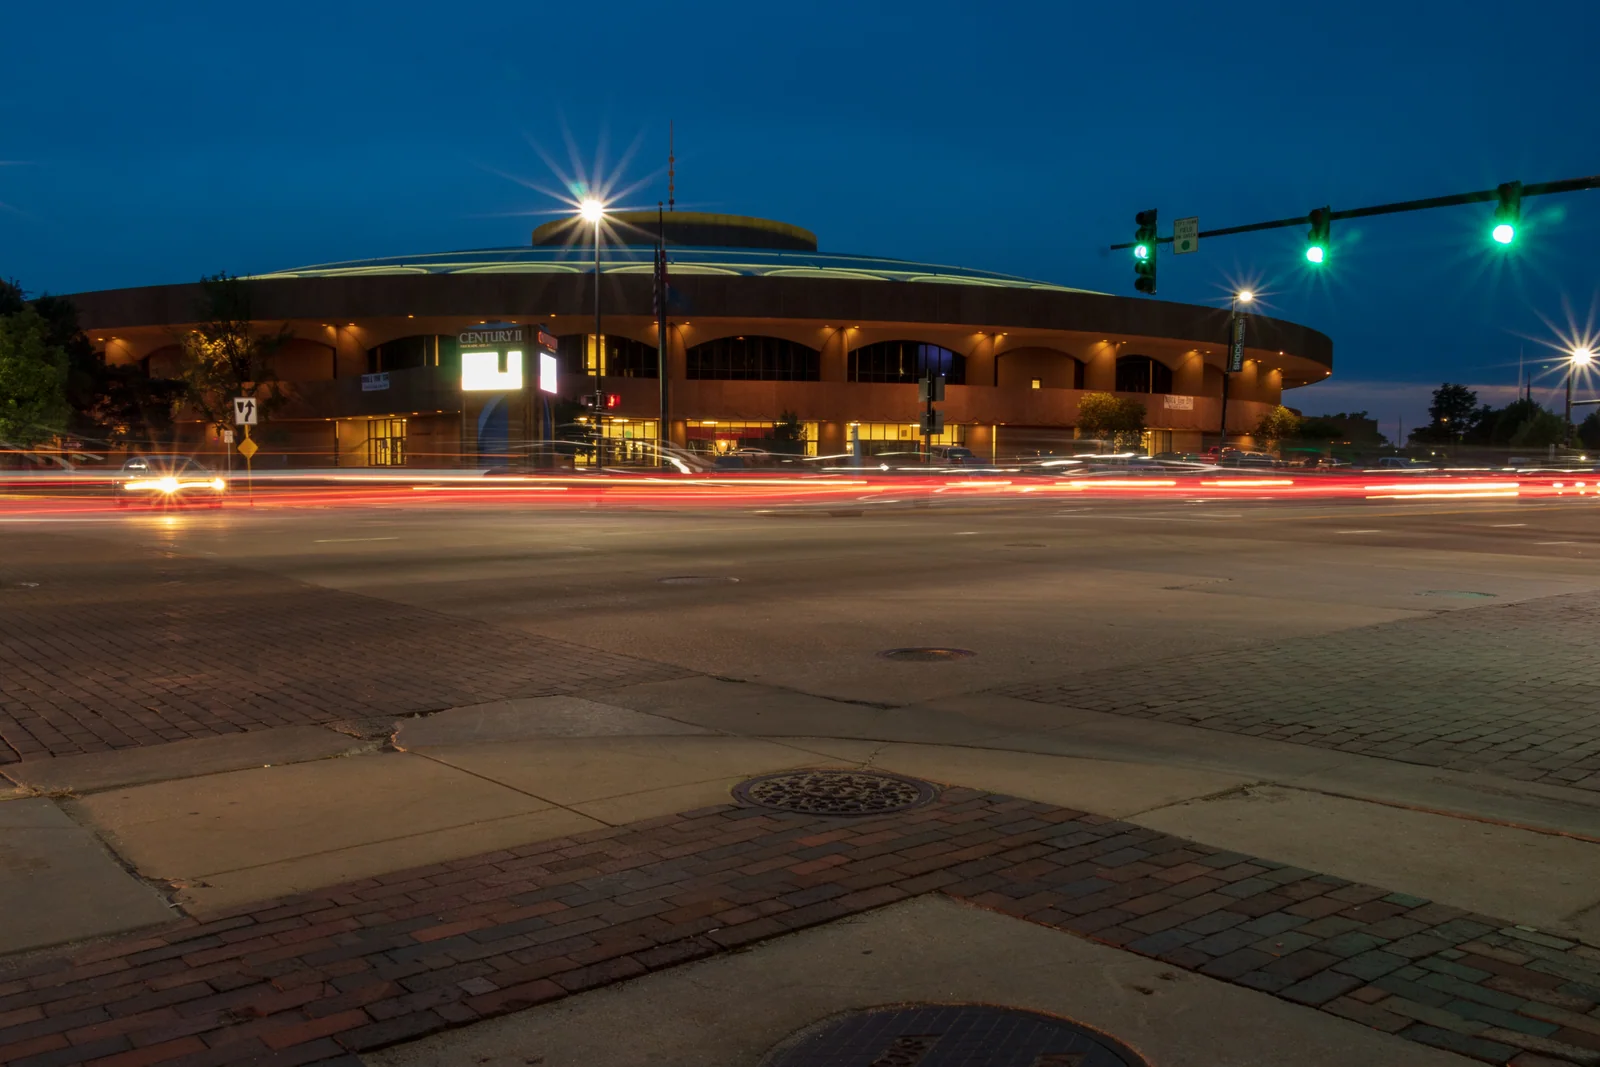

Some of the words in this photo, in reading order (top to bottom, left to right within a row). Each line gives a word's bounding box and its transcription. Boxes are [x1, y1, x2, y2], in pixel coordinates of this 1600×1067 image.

[459, 330, 513, 344] CENTURY
[515, 330, 523, 341] II
[1233, 343, 1242, 370] SHOCK
